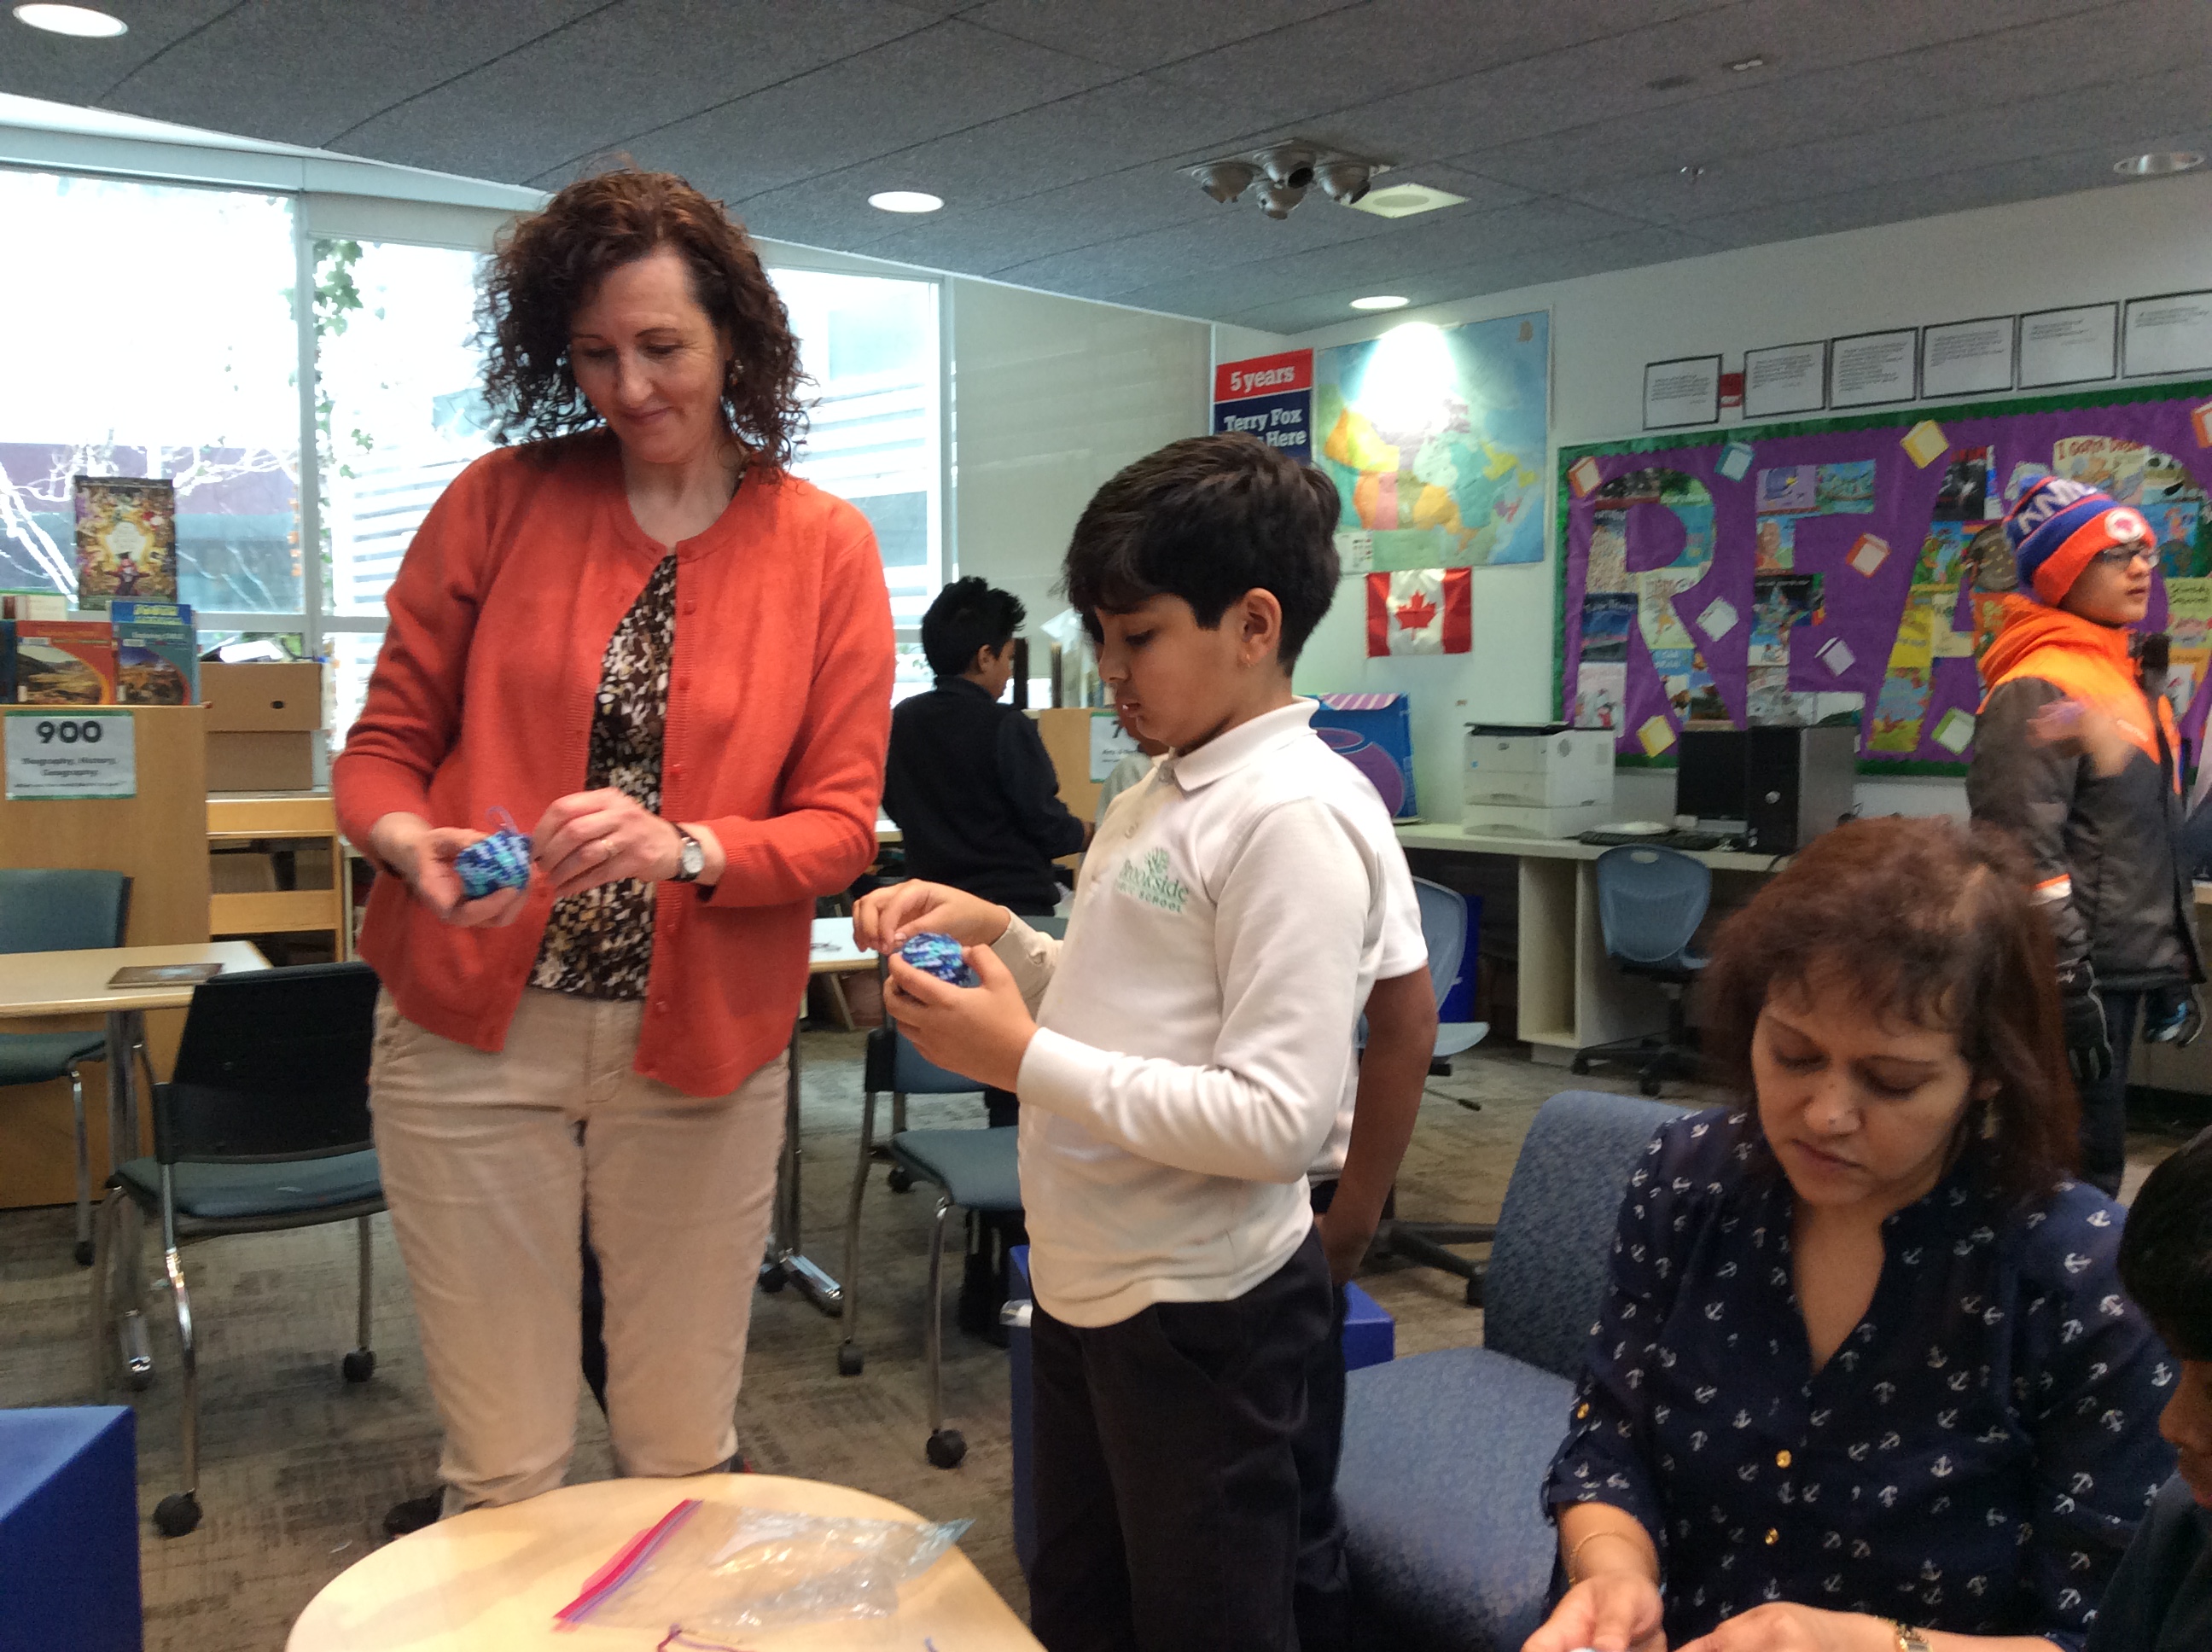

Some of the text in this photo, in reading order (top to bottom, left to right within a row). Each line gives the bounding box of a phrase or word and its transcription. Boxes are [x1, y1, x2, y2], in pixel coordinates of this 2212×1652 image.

[1230, 366, 1295, 393] 5 years
[1223, 408, 1303, 431] Terry Fox
[1266, 430, 1307, 447] Here
[37, 720, 102, 743] 900
